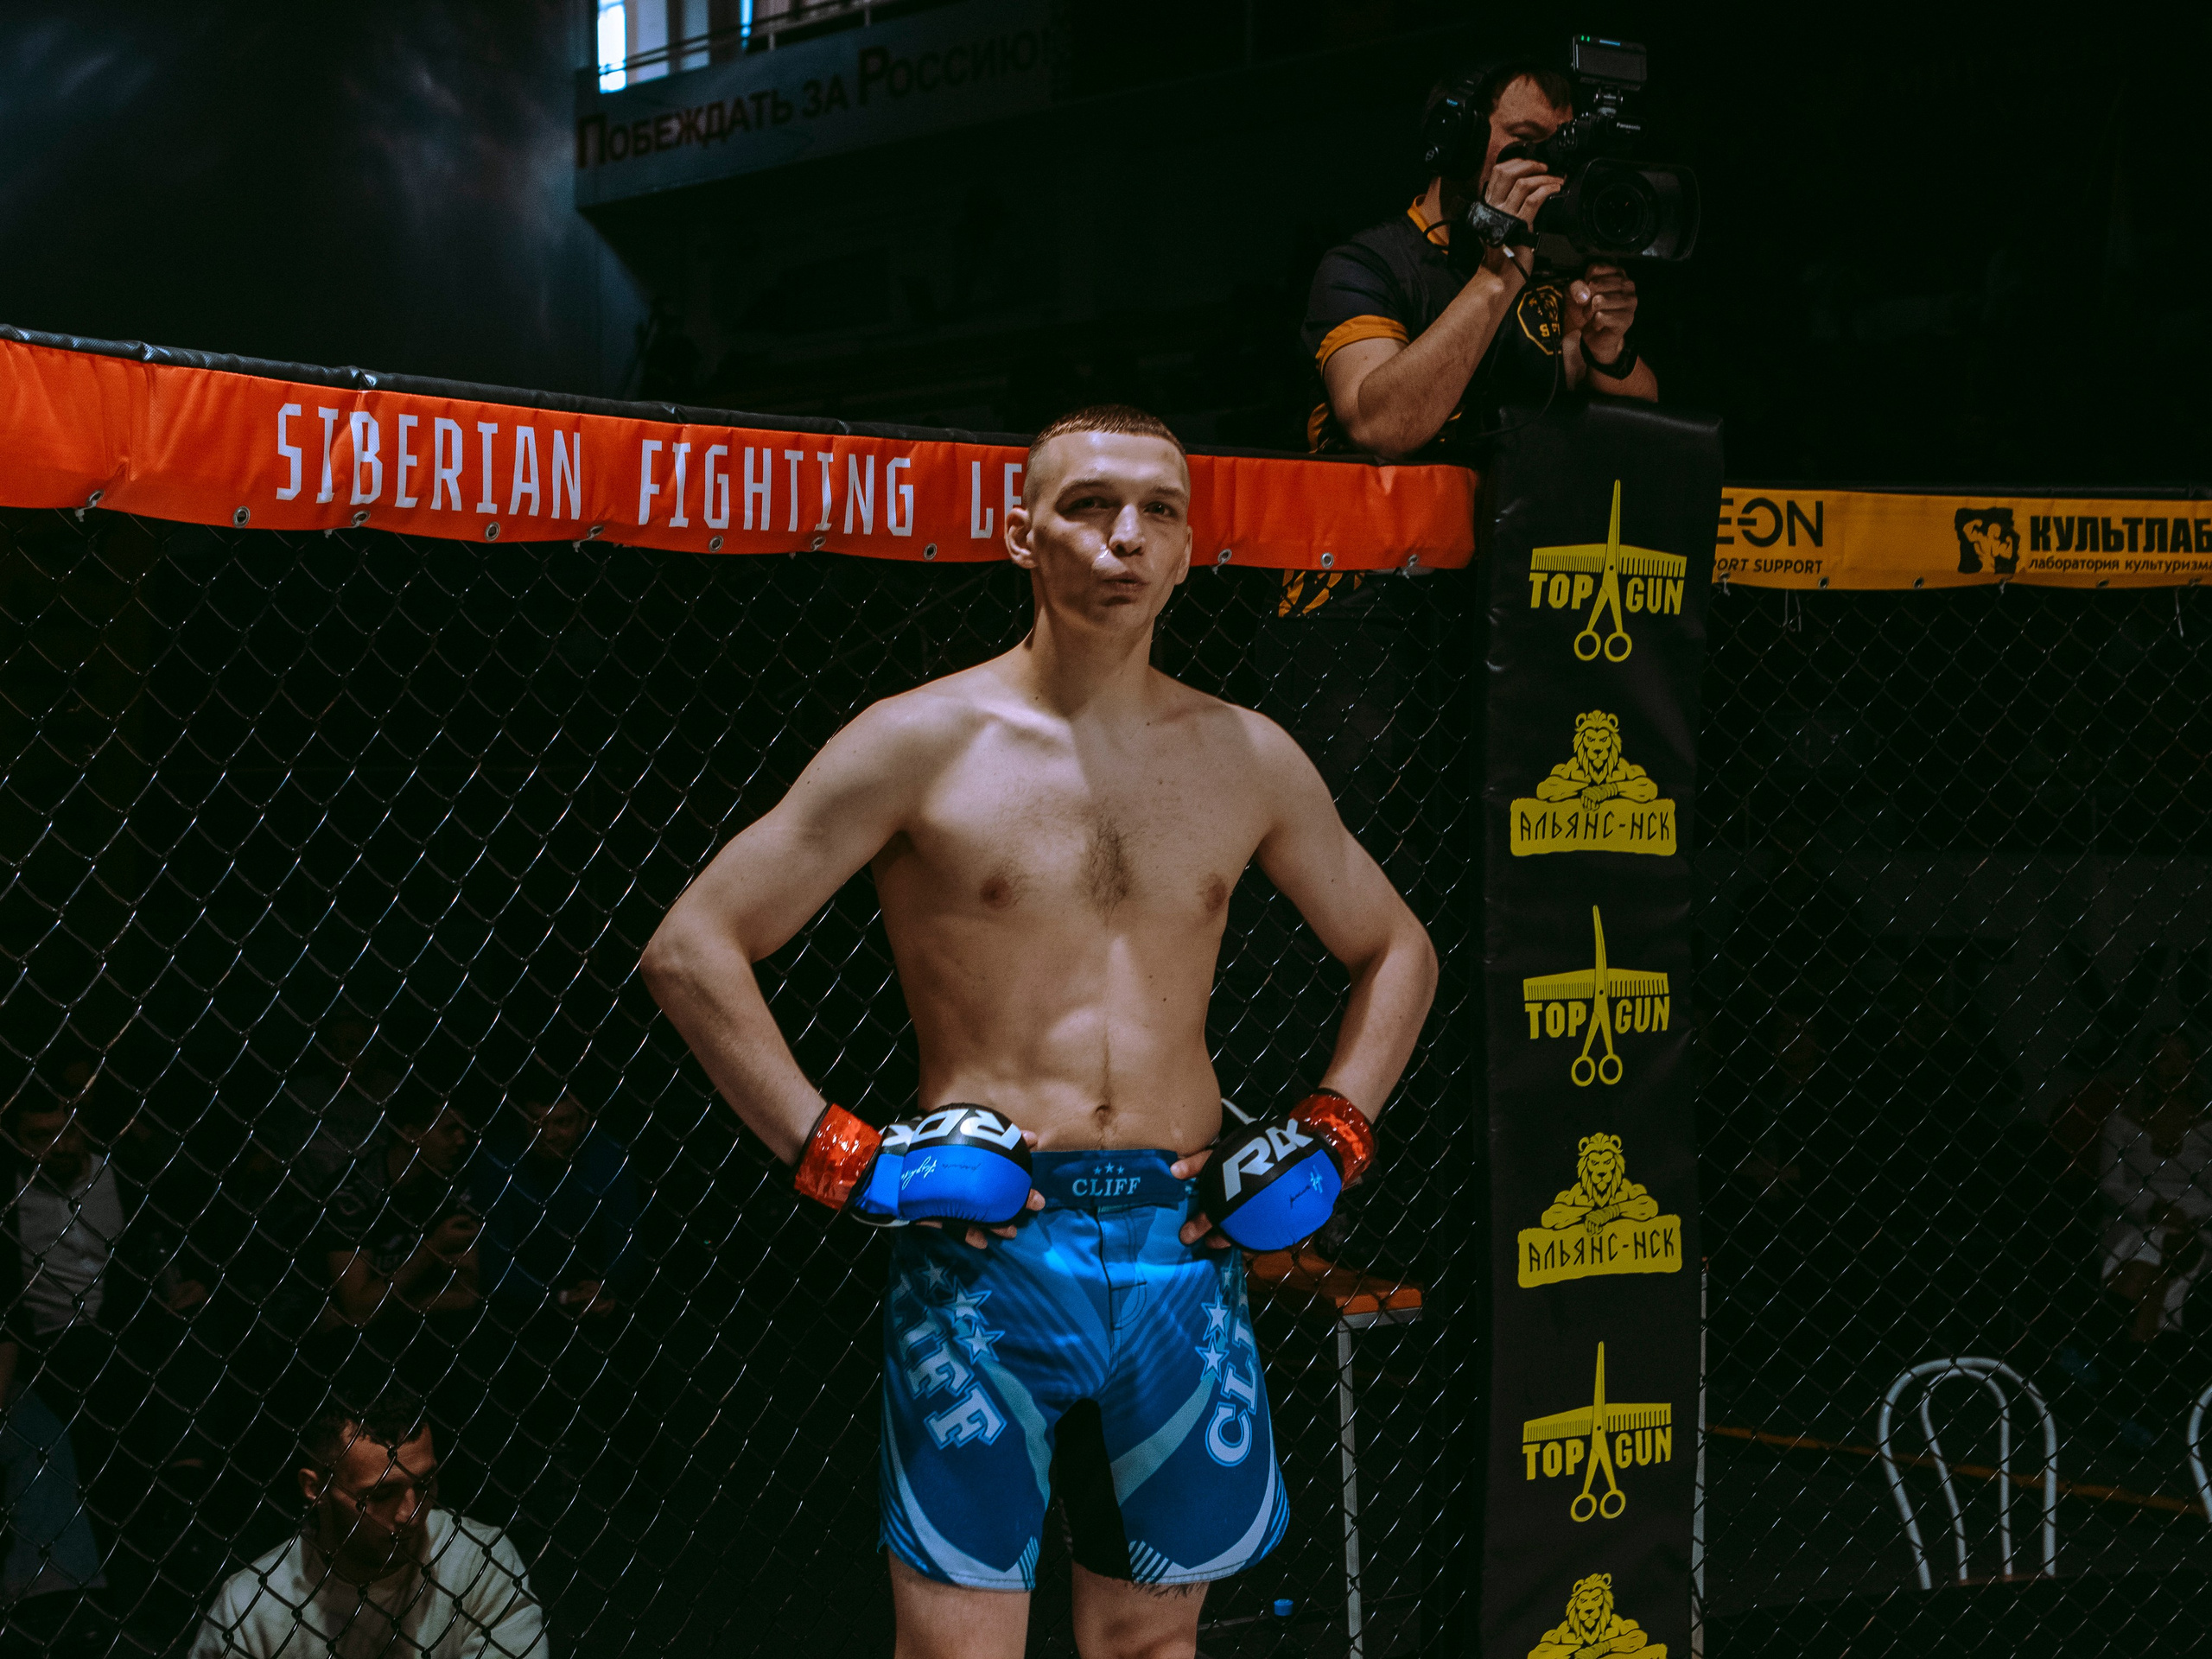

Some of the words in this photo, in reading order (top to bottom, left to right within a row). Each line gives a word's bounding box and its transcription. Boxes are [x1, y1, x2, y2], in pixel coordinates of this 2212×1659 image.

[276, 403, 582, 520] SIBERIAN
[638, 439, 914, 537] FIGHTING
[2031, 516, 2212, 553] КУЛЬТЛАБ
[1753, 558, 1823, 574] SUPPORT
[2029, 555, 2120, 573] лаборатория
[1529, 572, 1594, 610] TOP
[1625, 577, 1685, 615] GUN
[1524, 1001, 1587, 1039] TOP
[1615, 995, 1670, 1034] GUN
[1072, 1177, 1141, 1197] CLIFF
[1522, 1439, 1585, 1481] TOP
[1615, 1426, 1672, 1469] GUN
